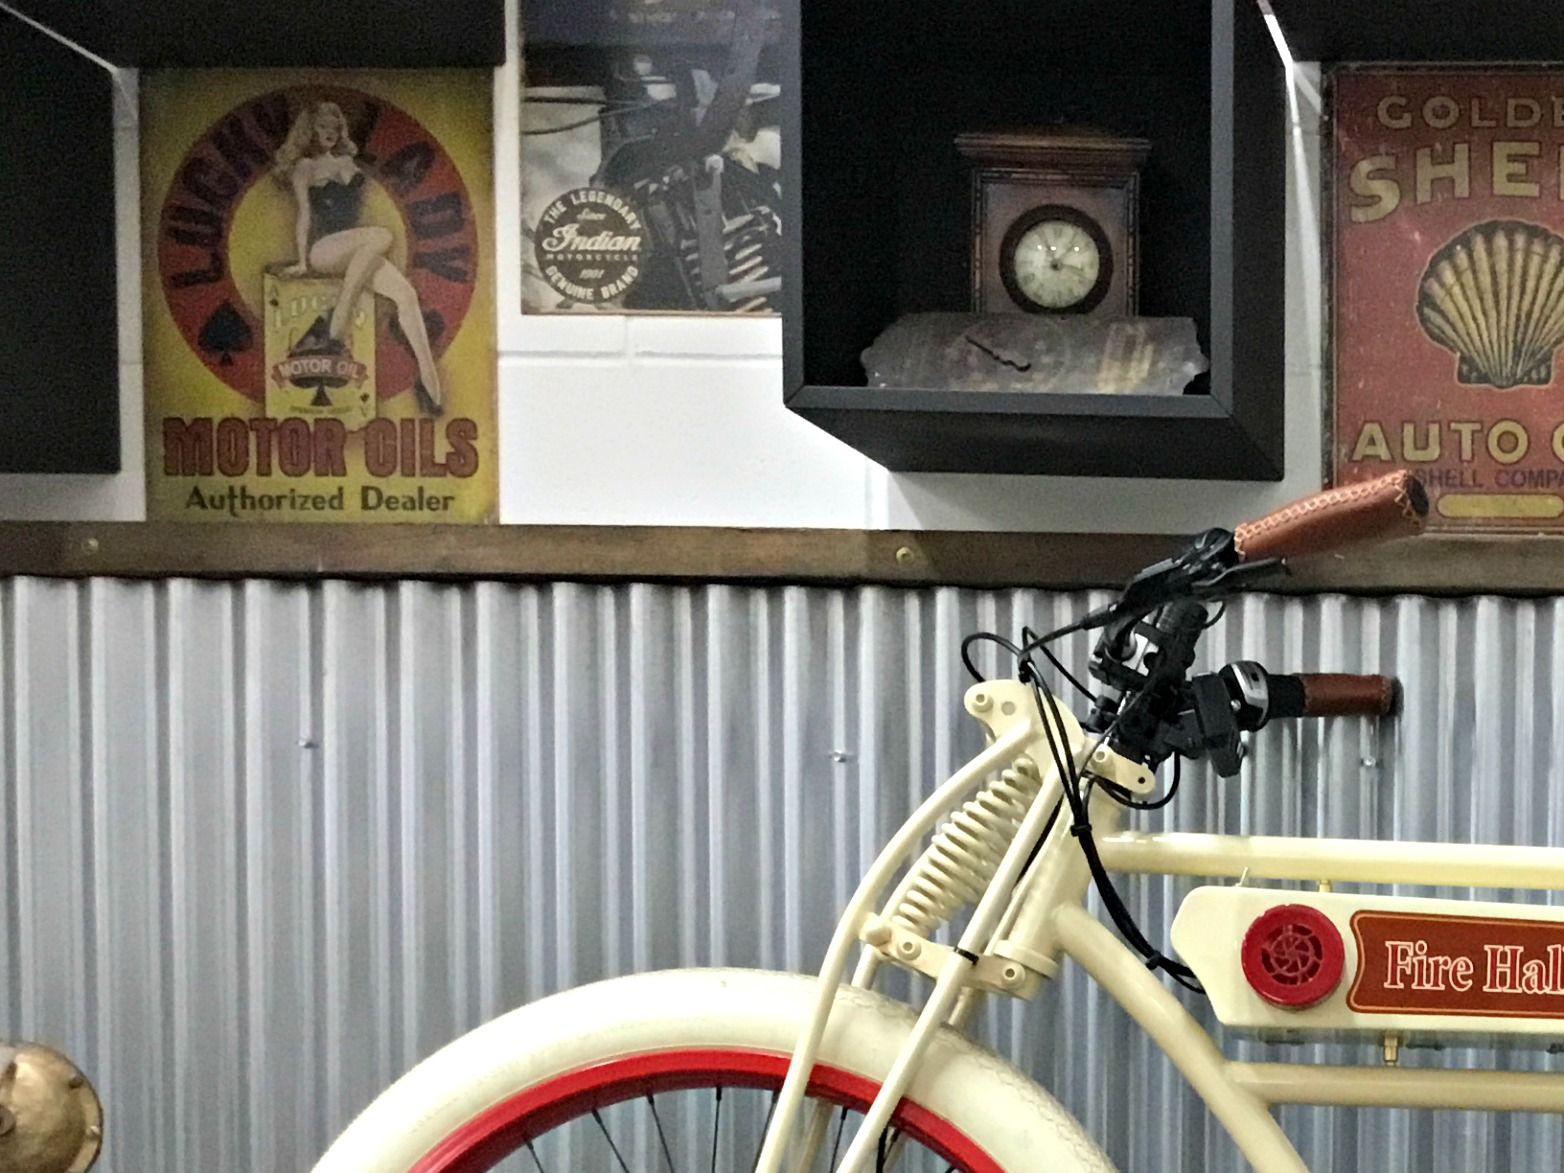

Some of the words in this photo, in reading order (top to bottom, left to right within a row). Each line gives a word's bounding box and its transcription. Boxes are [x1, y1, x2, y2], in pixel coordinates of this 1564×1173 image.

[544, 201, 567, 224] THE
[570, 190, 641, 229] LEGENDARY
[542, 224, 641, 251] Indian
[545, 265, 594, 300] GENUINE
[600, 266, 639, 299] BRAND
[278, 359, 332, 377] MOTOR
[336, 361, 359, 378] OIL
[163, 417, 349, 478] MOTOR
[364, 417, 479, 478] OILS
[1350, 419, 1530, 464] AUTO
[1415, 468, 1484, 488] SHELL
[185, 485, 344, 517] Authorized
[361, 485, 455, 512] Dealer
[1384, 941, 1474, 991] Fire
